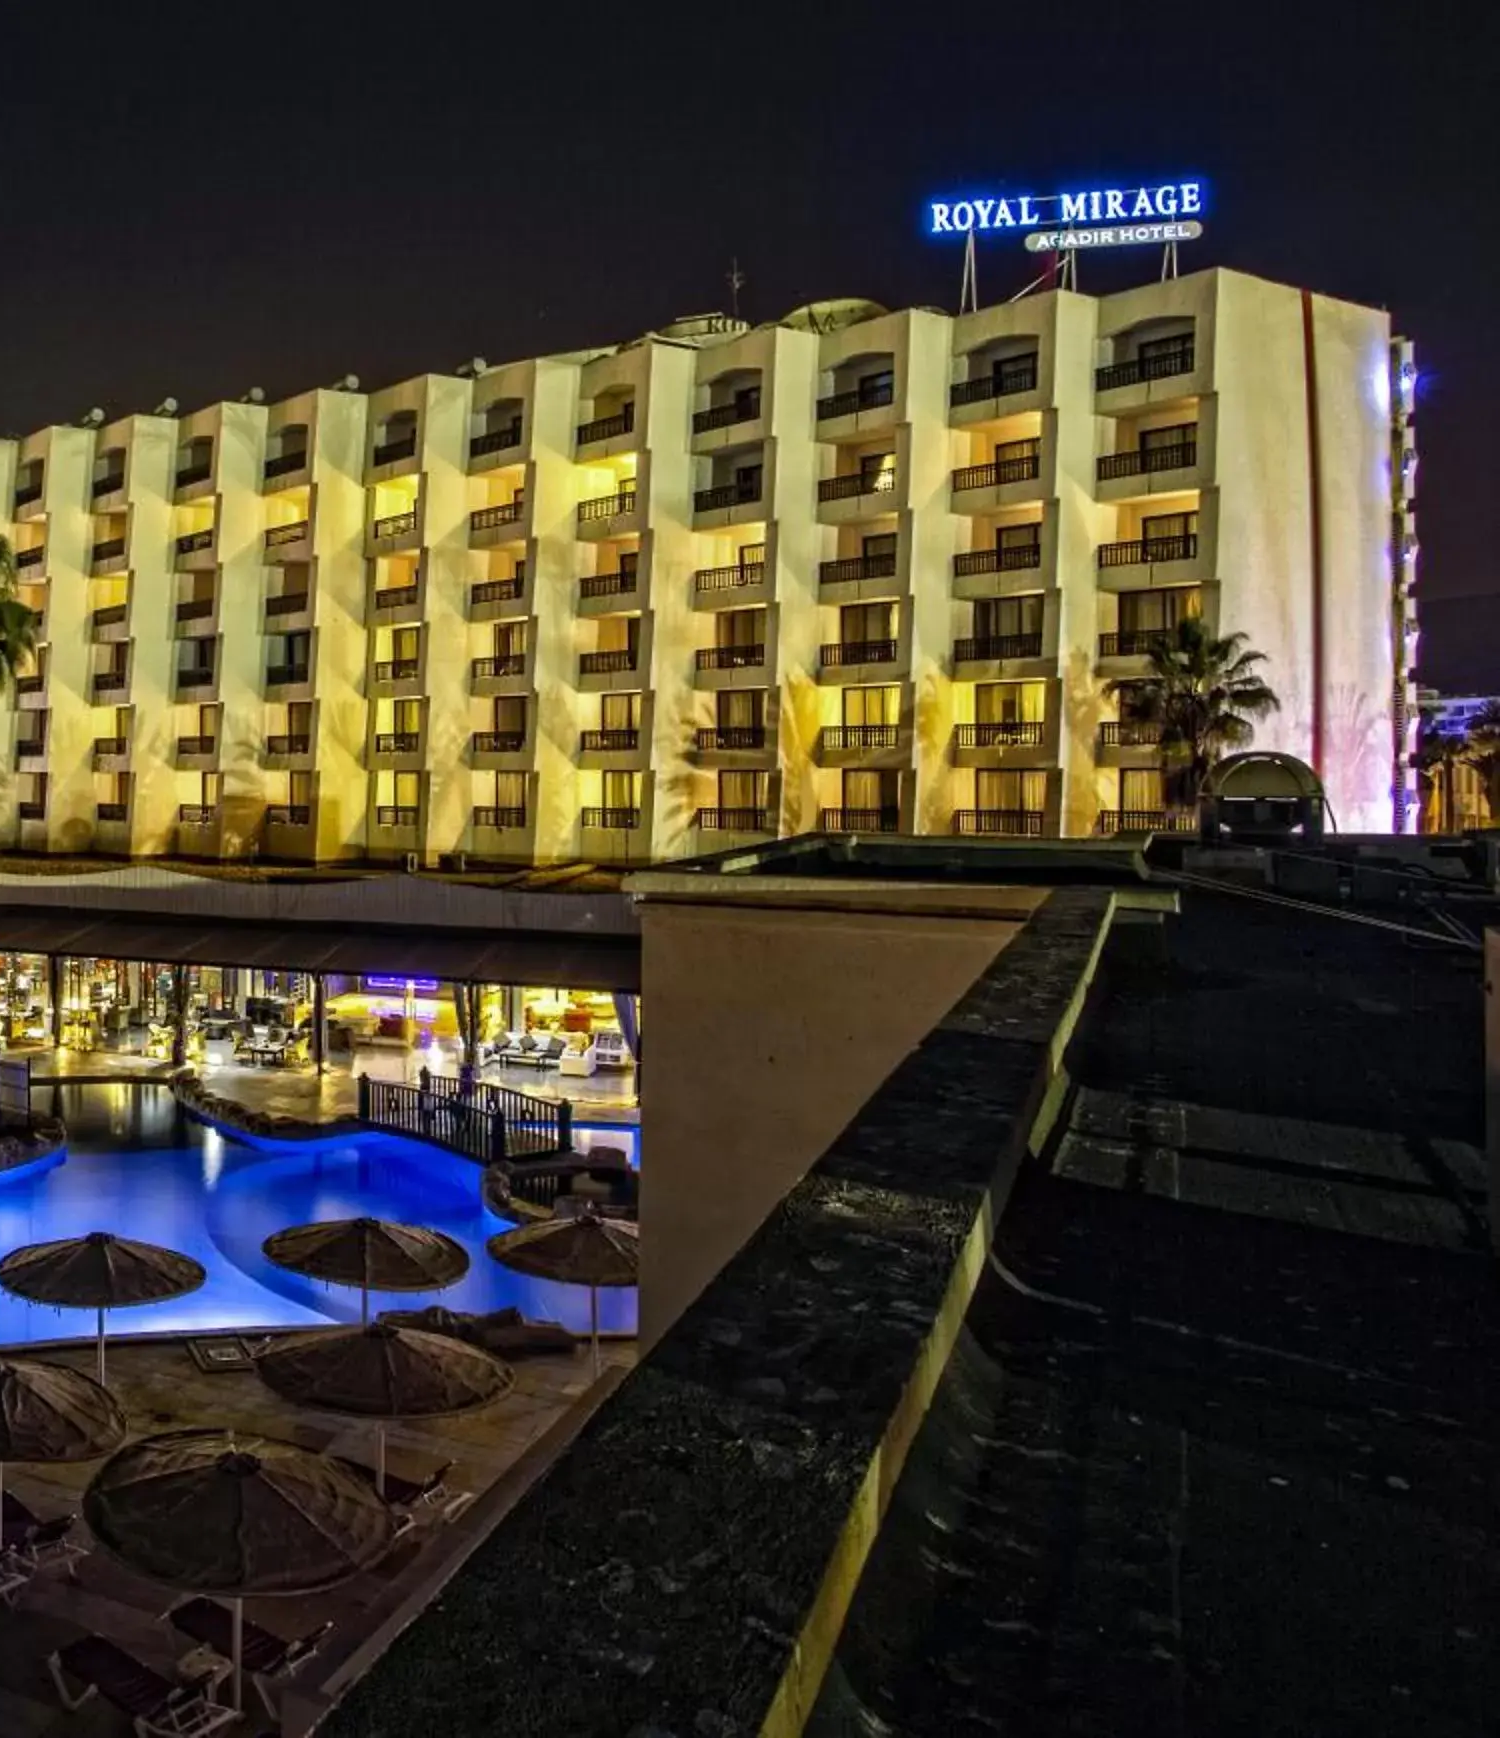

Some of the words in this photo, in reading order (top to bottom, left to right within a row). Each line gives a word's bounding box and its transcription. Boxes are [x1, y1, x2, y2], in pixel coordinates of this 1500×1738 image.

[931, 197, 1039, 232] ROYAL
[1061, 184, 1201, 222] MIRAGE
[1036, 231, 1114, 249] AGADIR
[1119, 225, 1191, 241] HOTEL
